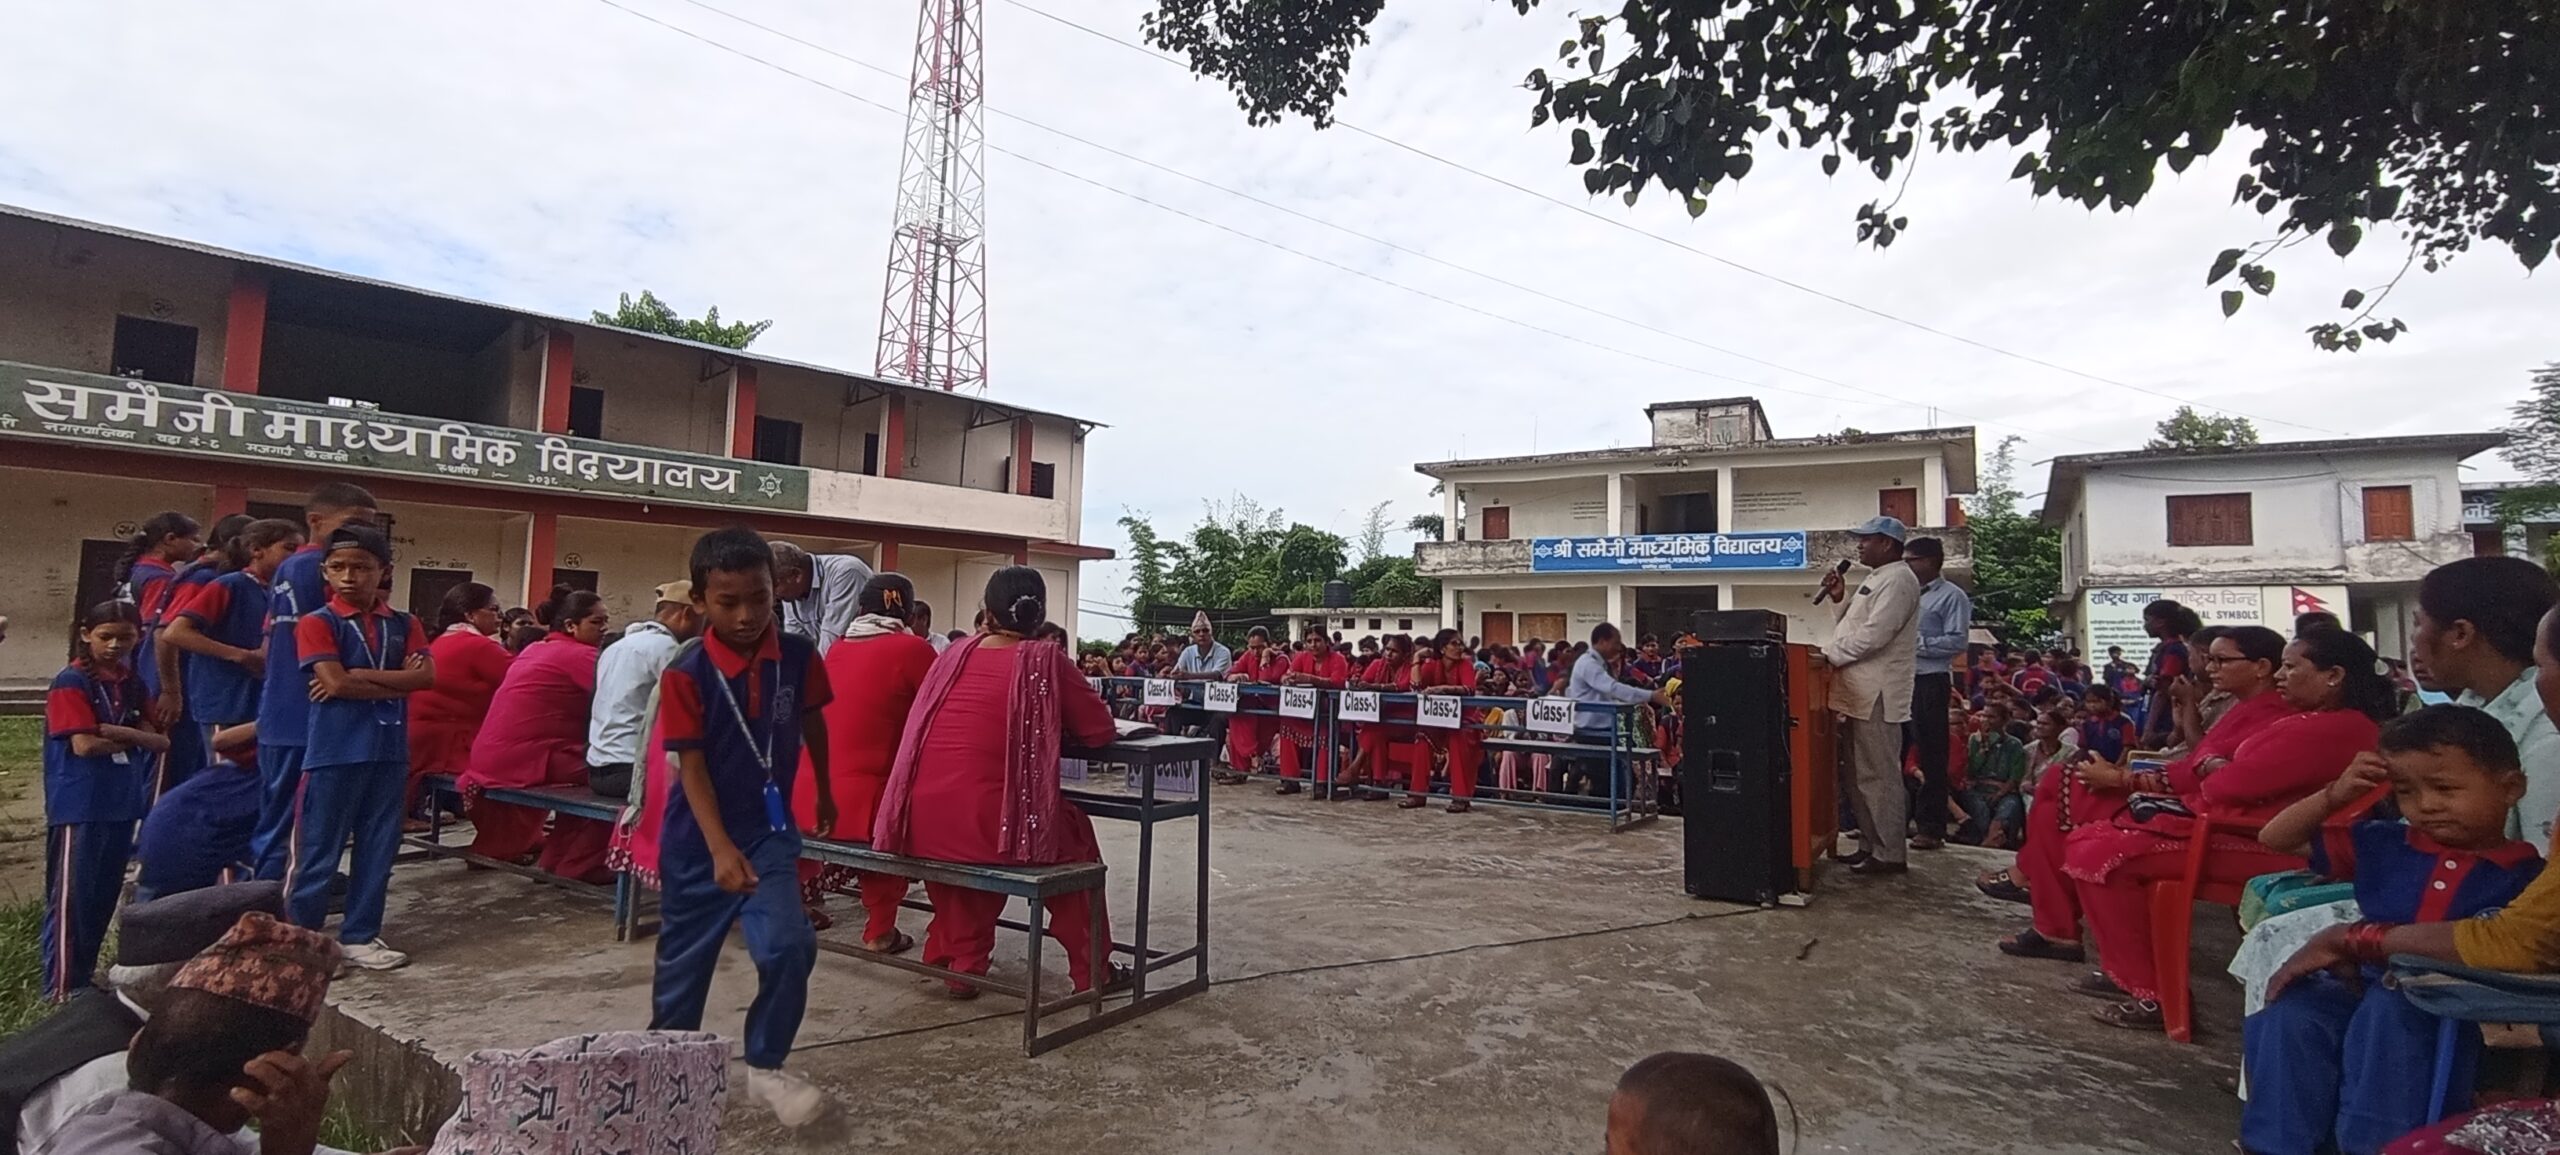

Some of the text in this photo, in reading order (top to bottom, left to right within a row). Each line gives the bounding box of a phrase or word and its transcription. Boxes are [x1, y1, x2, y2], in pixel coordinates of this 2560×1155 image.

[22, 379, 256, 438] समैजी
[262, 409, 522, 467] माध्यमिक
[1553, 538, 1573, 558] श्री
[1628, 536, 1710, 557] माध्यमिक
[1712, 535, 1783, 555] विद्यालय
[2090, 590, 2128, 606] राष्ट्रिय
[2216, 610, 2259, 620] SYMBOLS
[1208, 683, 1236, 704] Class-5
[1284, 688, 1314, 710] Class-4
[1344, 691, 1378, 713] Class-3
[1423, 695, 1459, 719] Class-2
[1531, 700, 1572, 724] Class-1
